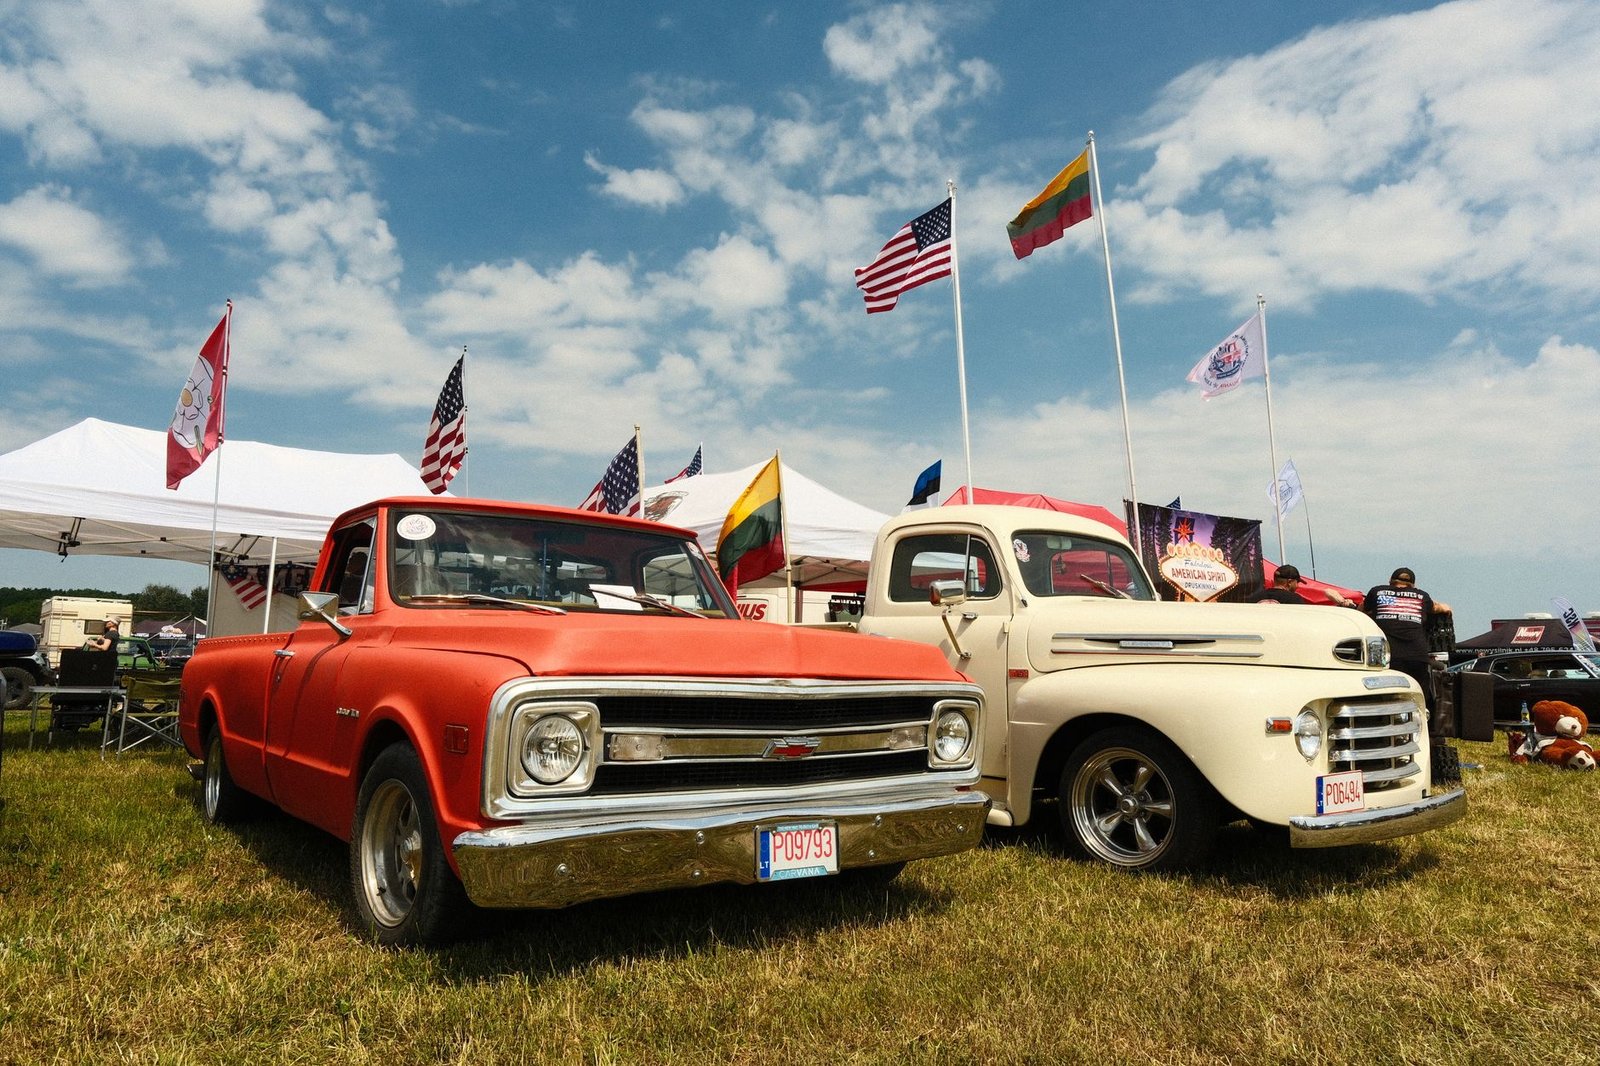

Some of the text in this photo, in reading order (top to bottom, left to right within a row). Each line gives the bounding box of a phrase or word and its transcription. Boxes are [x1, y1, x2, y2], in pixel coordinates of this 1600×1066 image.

[1168, 545, 1223, 559] WELCOME
[1172, 568, 1226, 582] AMERICAN SPIRIT
[1326, 780, 1360, 806] P06494
[772, 828, 832, 862] P09793
[760, 861, 769, 869] LT
[779, 867, 820, 877] CARVANA
